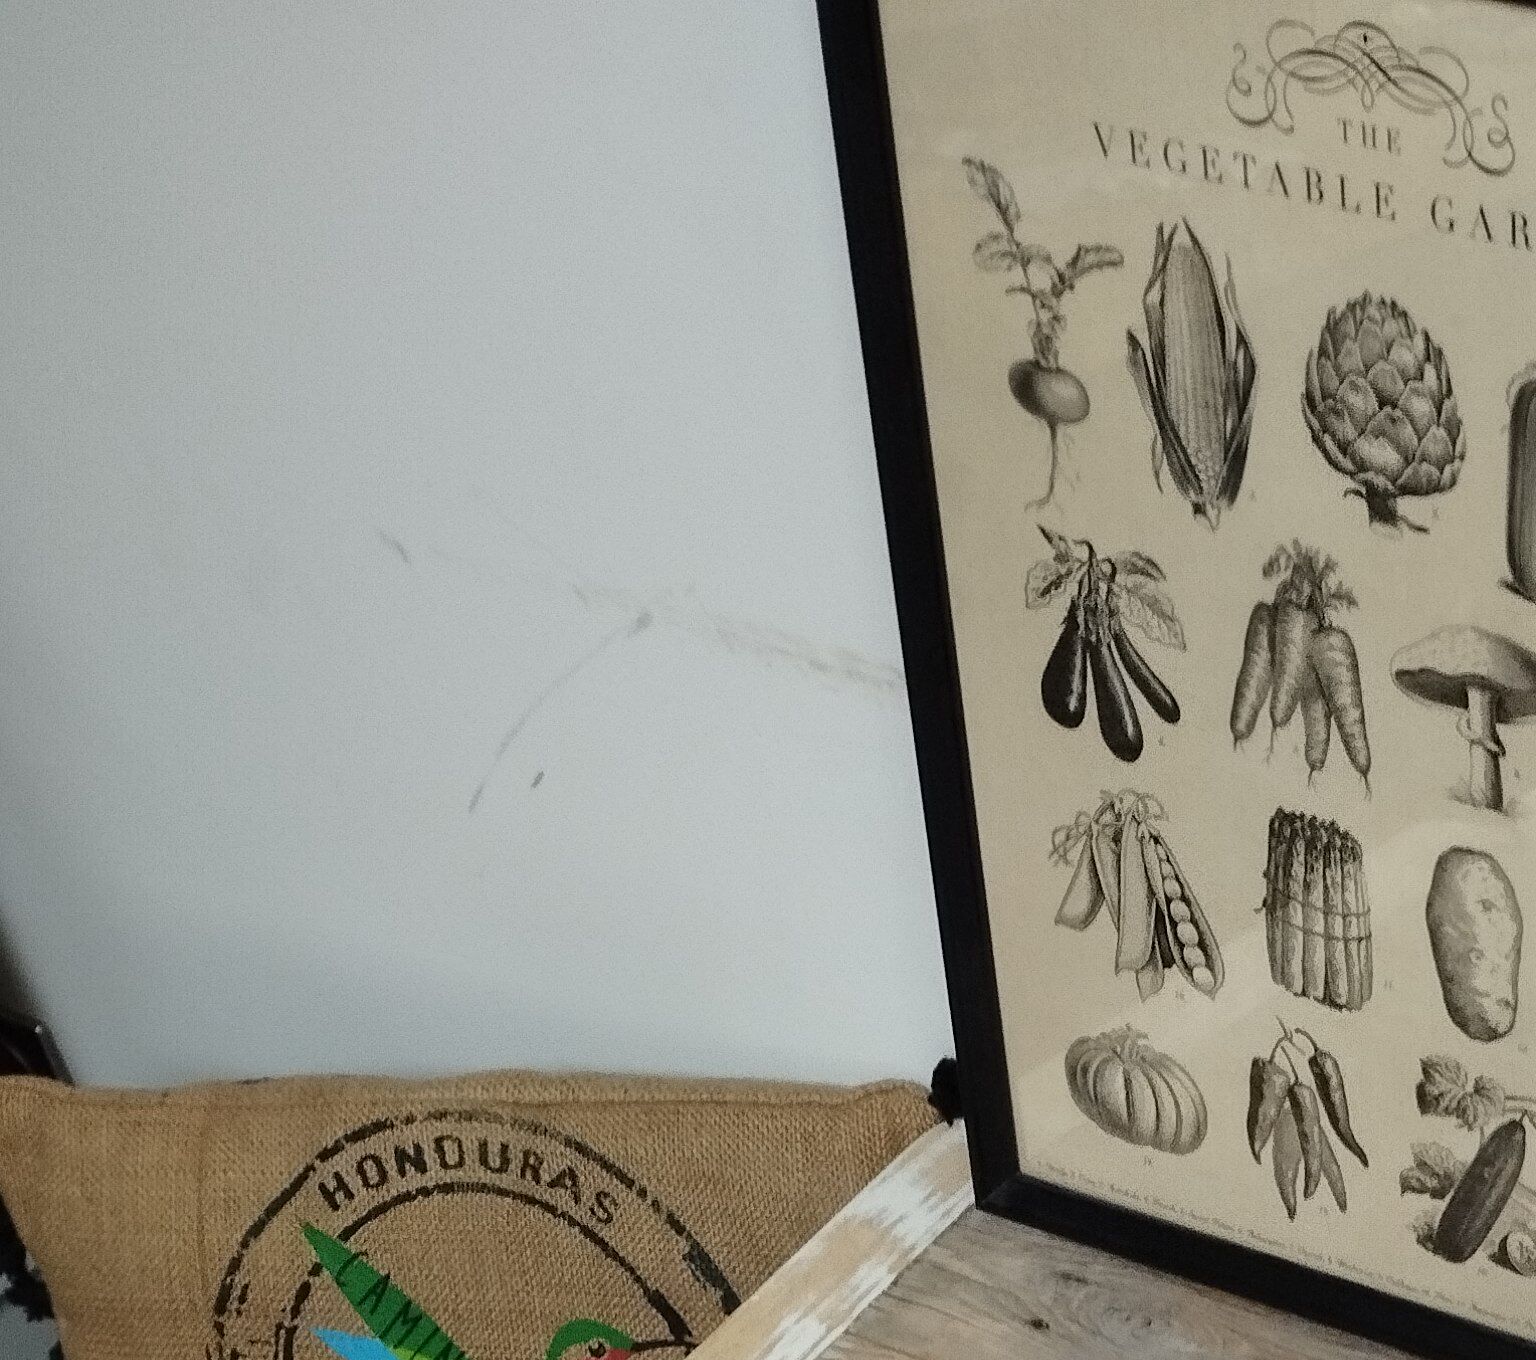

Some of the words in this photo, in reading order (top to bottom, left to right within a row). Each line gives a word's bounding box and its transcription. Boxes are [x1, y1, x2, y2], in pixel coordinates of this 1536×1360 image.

[1094, 121, 1398, 221] VEGETABLE
[1337, 118, 1402, 154] THE
[317, 1134, 620, 1225] HONDURAS
